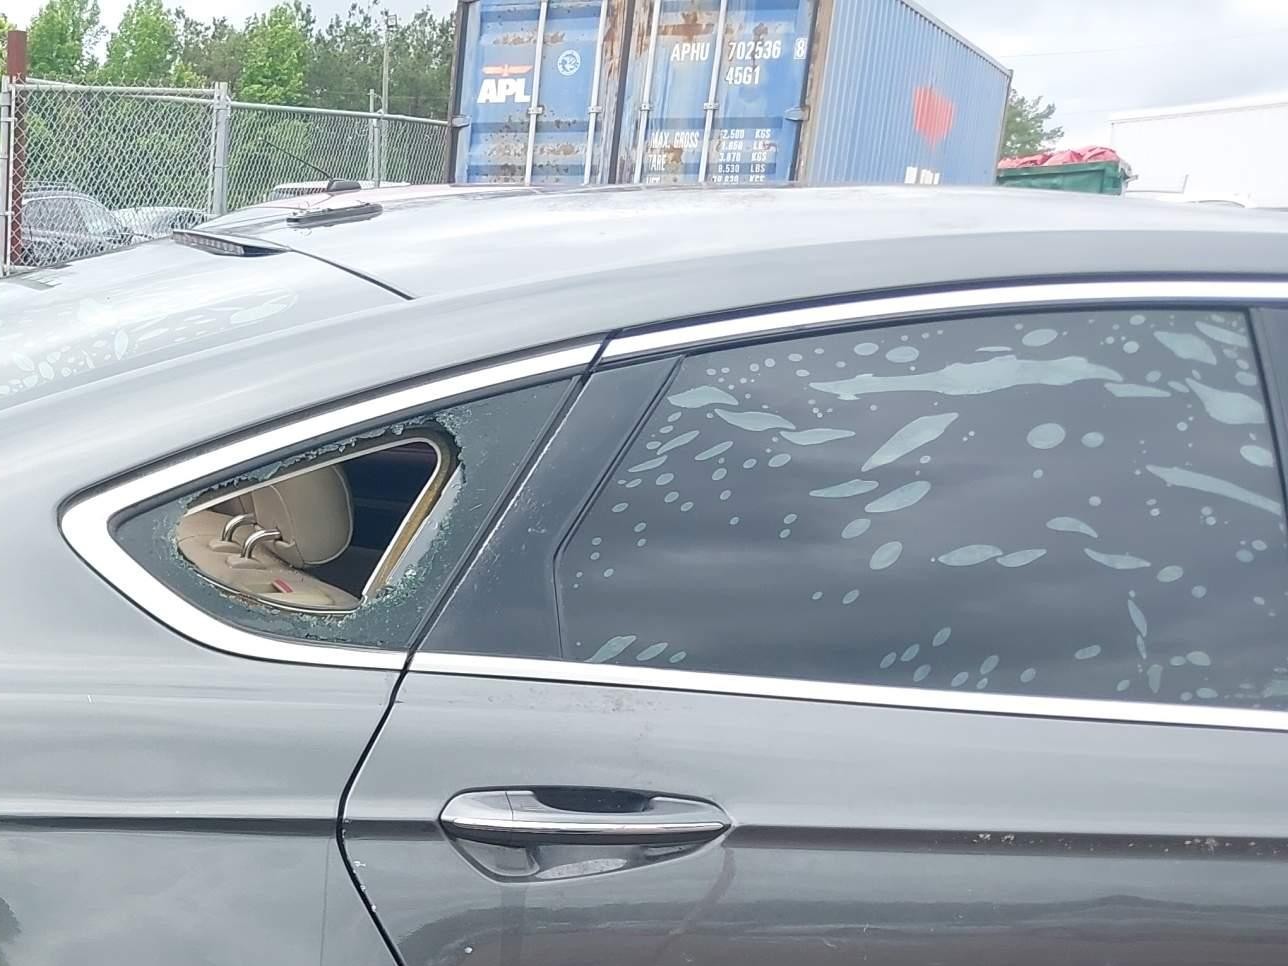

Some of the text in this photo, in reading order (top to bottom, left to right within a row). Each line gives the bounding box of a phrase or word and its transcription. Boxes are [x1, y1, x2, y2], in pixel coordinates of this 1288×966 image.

[670, 39, 807, 62] APHU 702536 8
[725, 66, 761, 86] 45G1
[476, 77, 532, 104] APL
[673, 130, 700, 149] GROSS
